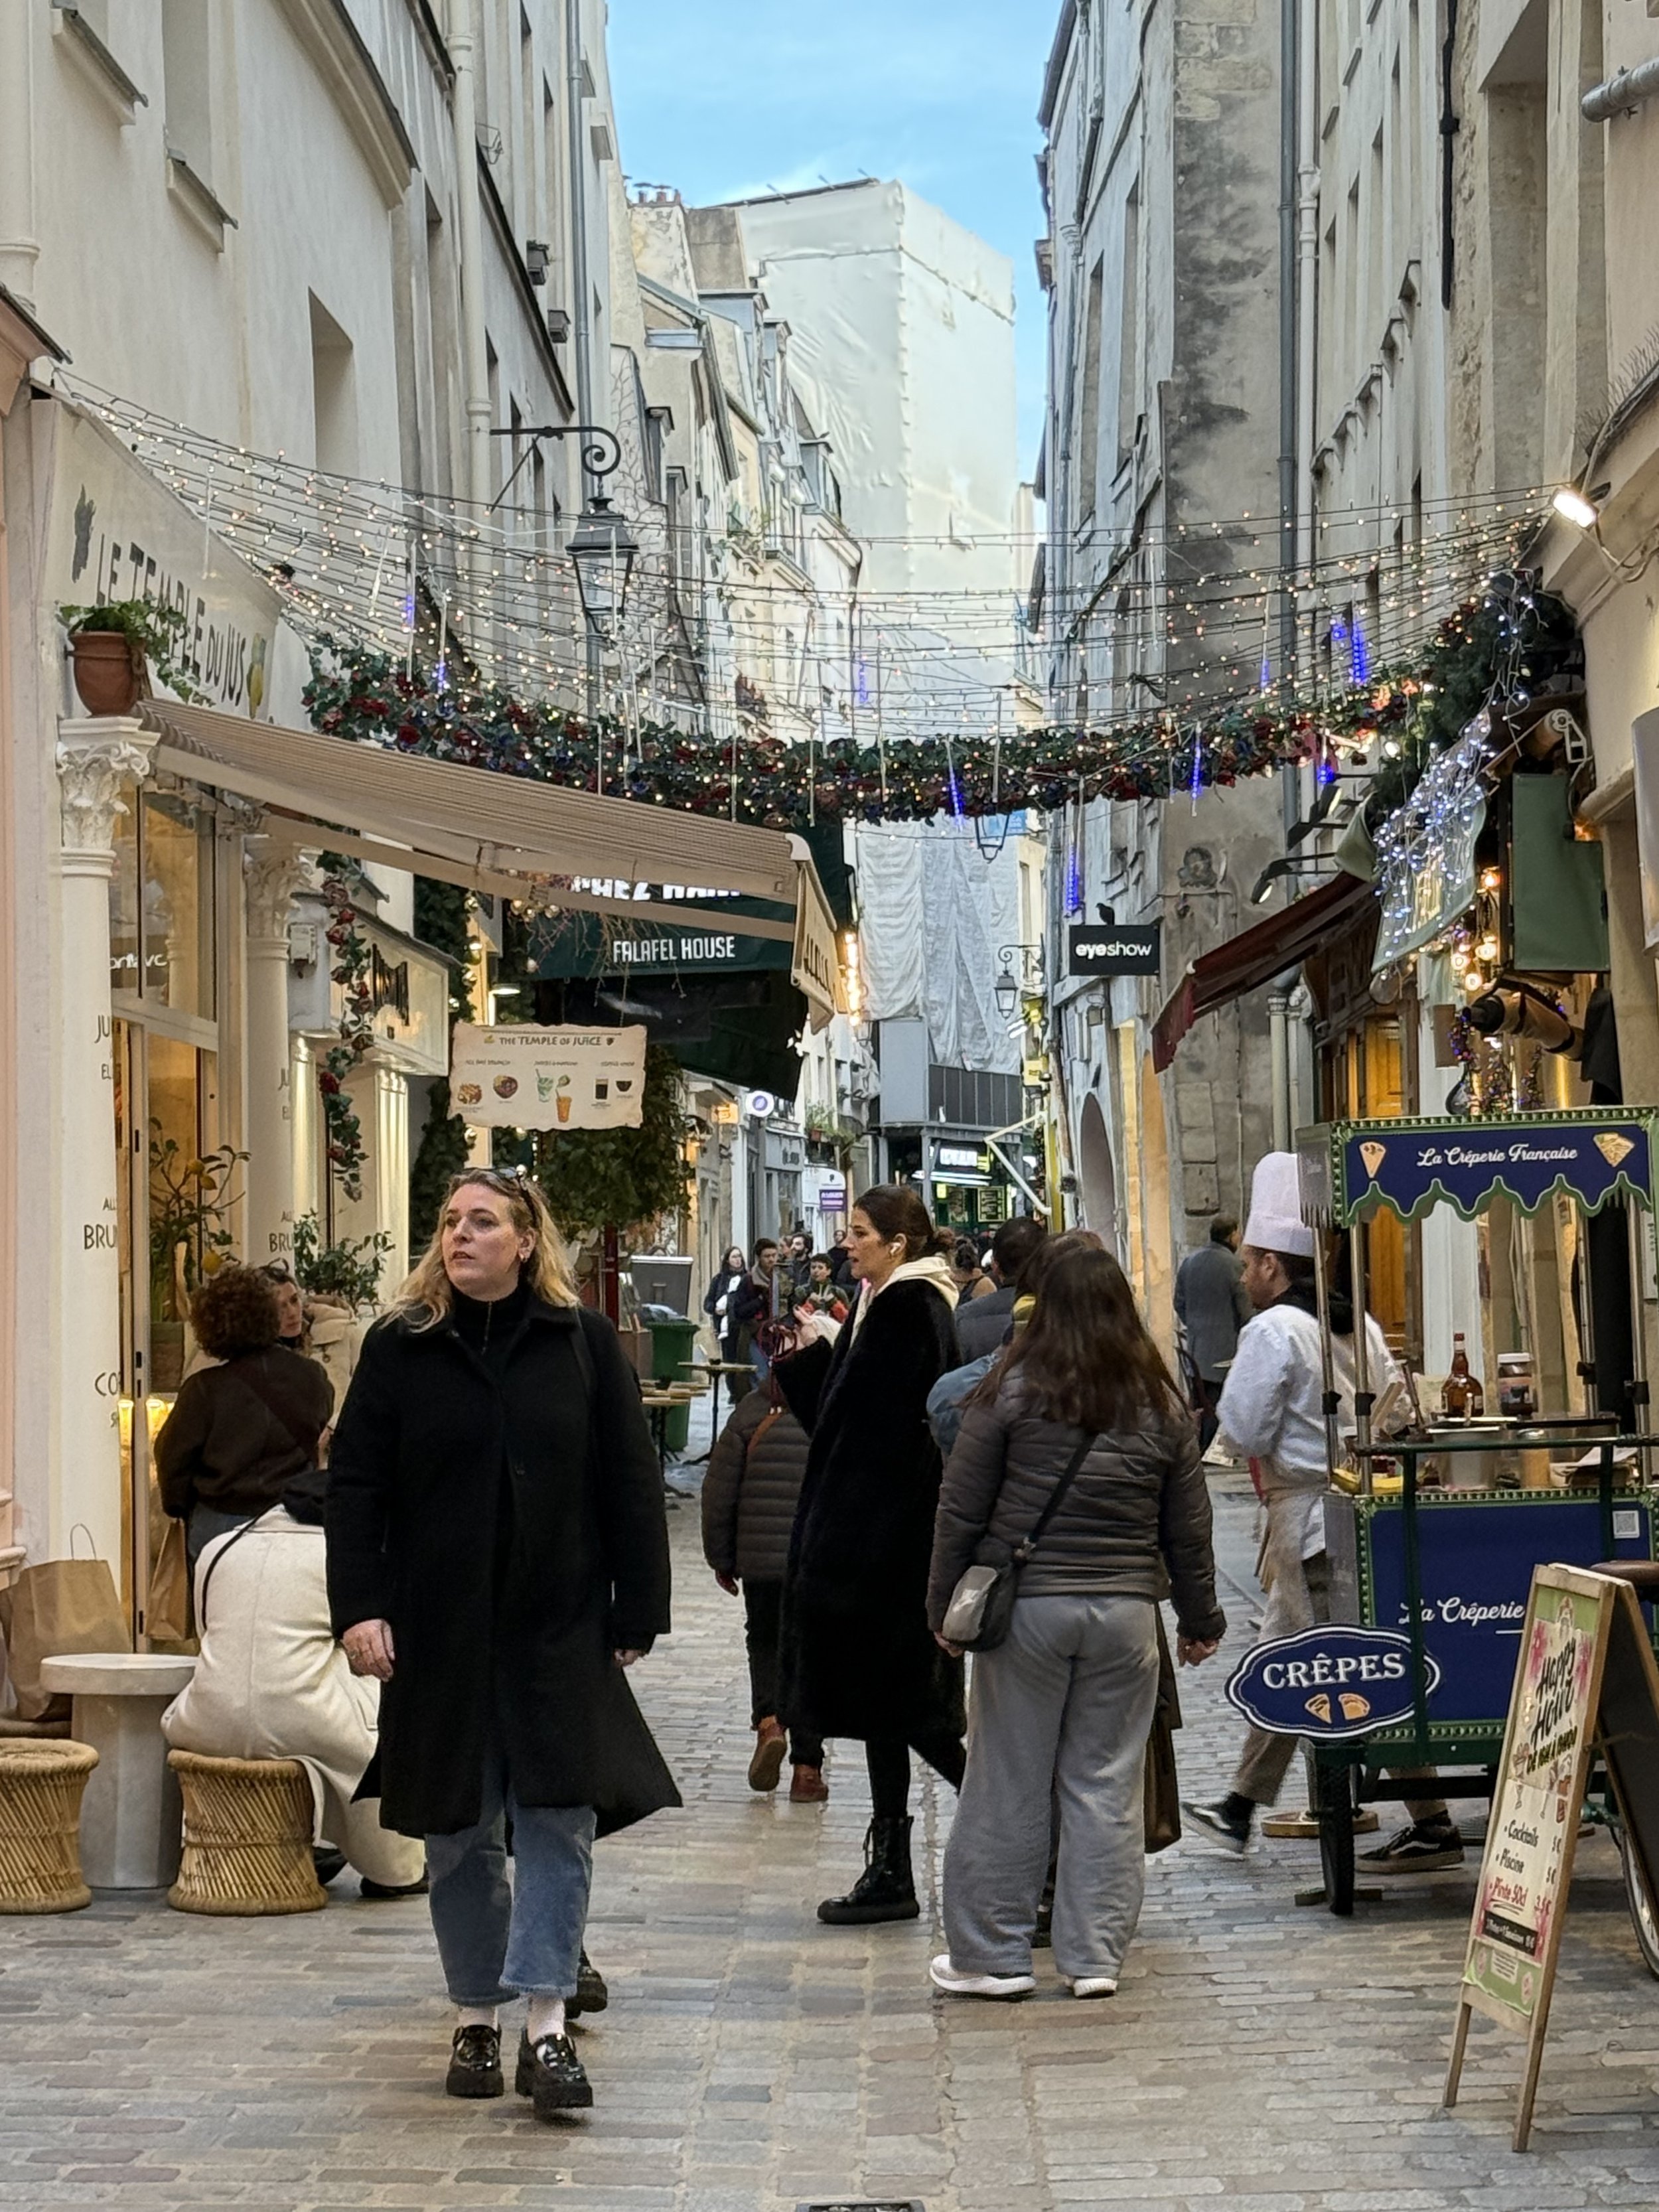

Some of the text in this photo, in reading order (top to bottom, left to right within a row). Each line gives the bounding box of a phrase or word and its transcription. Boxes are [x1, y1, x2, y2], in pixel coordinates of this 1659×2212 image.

[613, 936, 735, 963] FALAFEL HOUSE
[1076, 940, 1152, 960] eyeshow
[500, 1036, 516, 1045] THE
[518, 1035, 557, 1046] TEMPLE
[573, 1036, 601, 1047] JUICE
[1416, 1147, 1443, 1166] La
[1508, 1143, 1577, 1163] Française
[1437, 1597, 1526, 1627] Crêperie
[1263, 1653, 1406, 1689] CRÊPES
